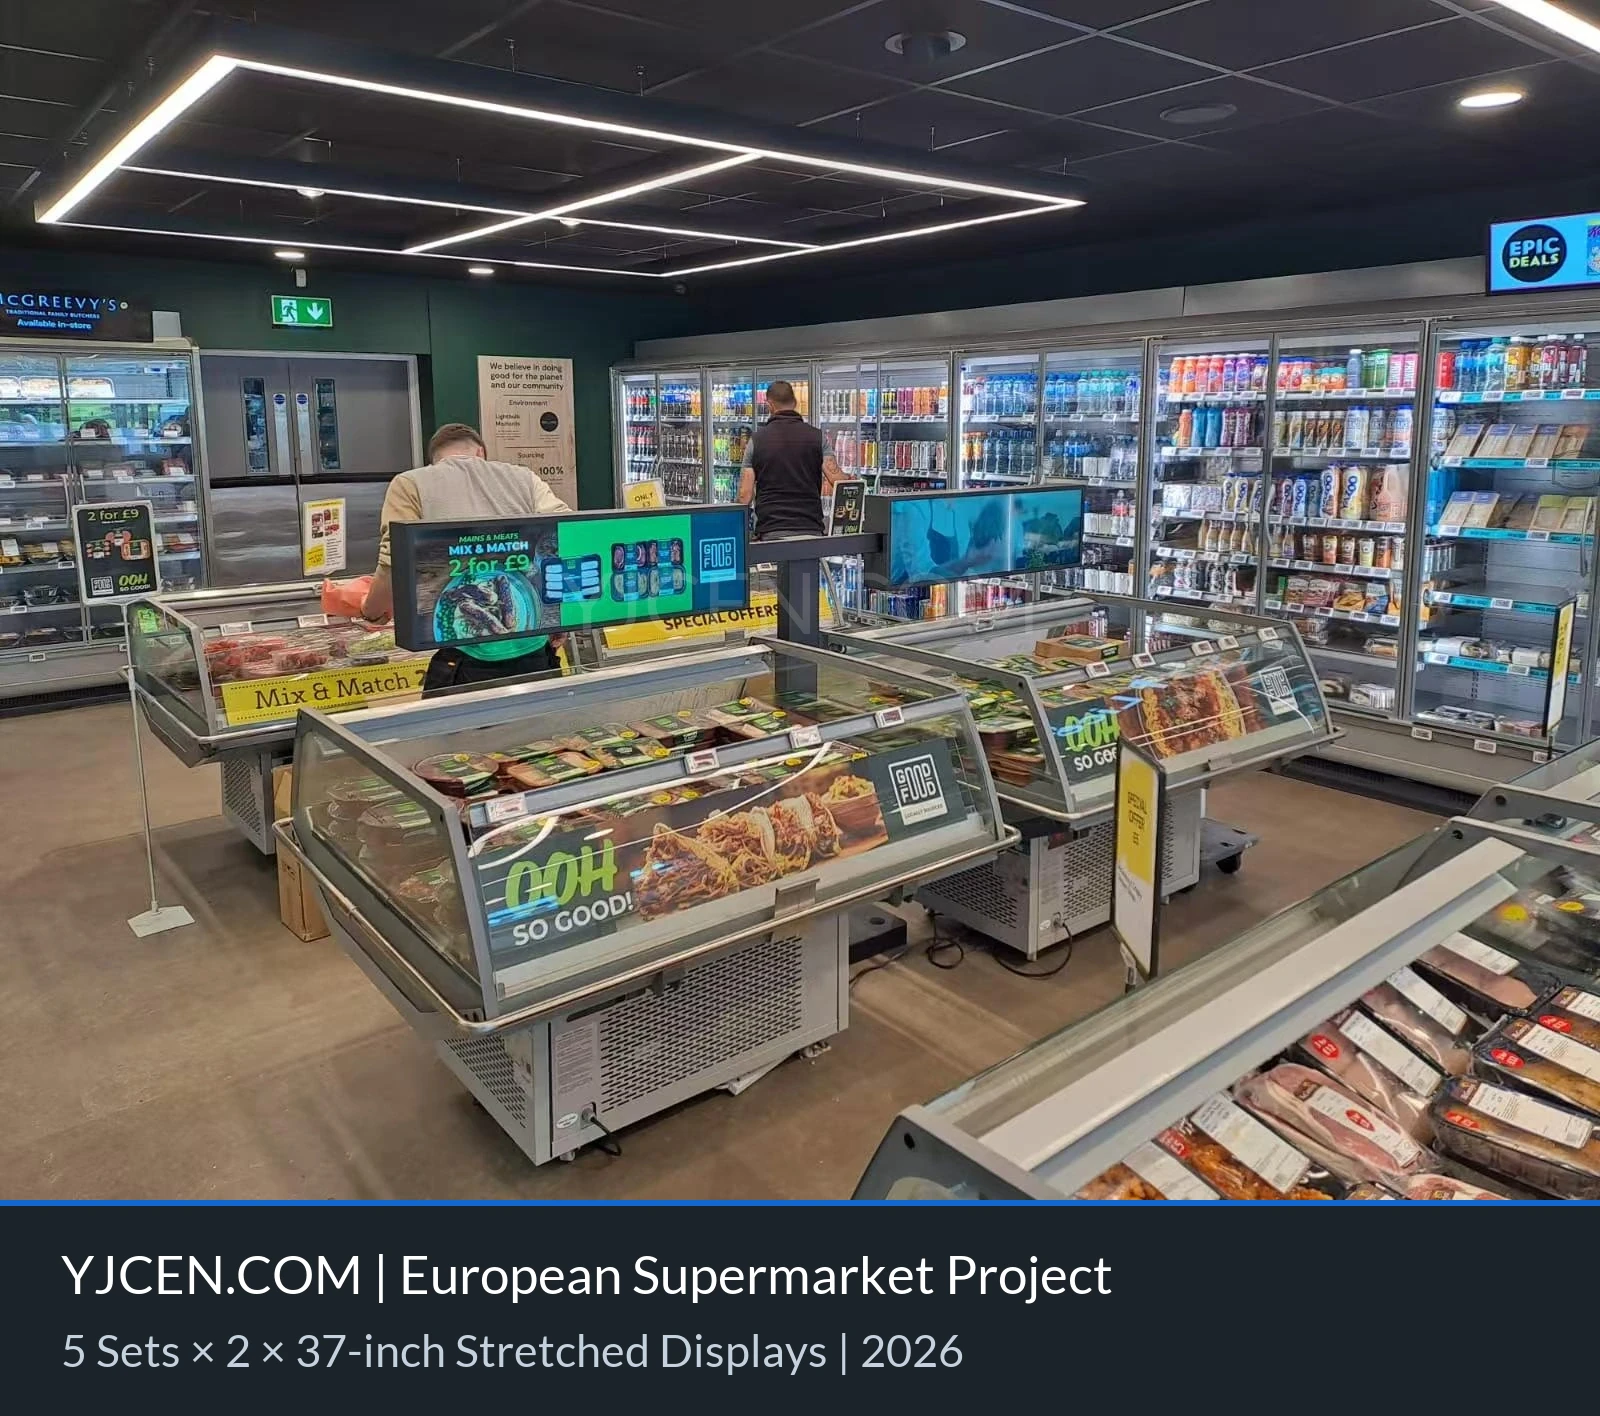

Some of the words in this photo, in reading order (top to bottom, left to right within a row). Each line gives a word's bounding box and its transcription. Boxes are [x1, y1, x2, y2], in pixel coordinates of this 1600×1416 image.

[1509, 237, 1560, 257] EPIC
[1509, 254, 1559, 269] DEALS
[17, 319, 56, 328] Available
[490, 362, 502, 370] We
[504, 363, 532, 371] believe
[533, 363, 540, 371] in
[542, 364, 563, 373] doing
[490, 373, 510, 381] good
[522, 383, 564, 391] community
[518, 451, 545, 459] Sourcing
[540, 466, 564, 475] 100%
[87, 511, 96, 521] 2
[100, 510, 118, 520] for
[123, 508, 139, 519] £9
[459, 535, 484, 543] MAINS
[449, 545, 472, 555] MIX
[475, 544, 484, 554] &
[486, 541, 529, 553] MATCH
[449, 559, 462, 577] 2
[468, 557, 498, 575] for
[504, 554, 530, 572] £9
[119, 573, 148, 586] OOH
[664, 611, 726, 631] SPECIAL
[255, 687, 308, 710] Mix
[313, 682, 330, 700] &
[337, 672, 410, 698] Match
[1065, 709, 1120, 752] OOH
[1074, 755, 1093, 771] SO
[505, 839, 617, 910] OOH
[513, 918, 548, 946] SO
[555, 891, 634, 932] GOOD!
